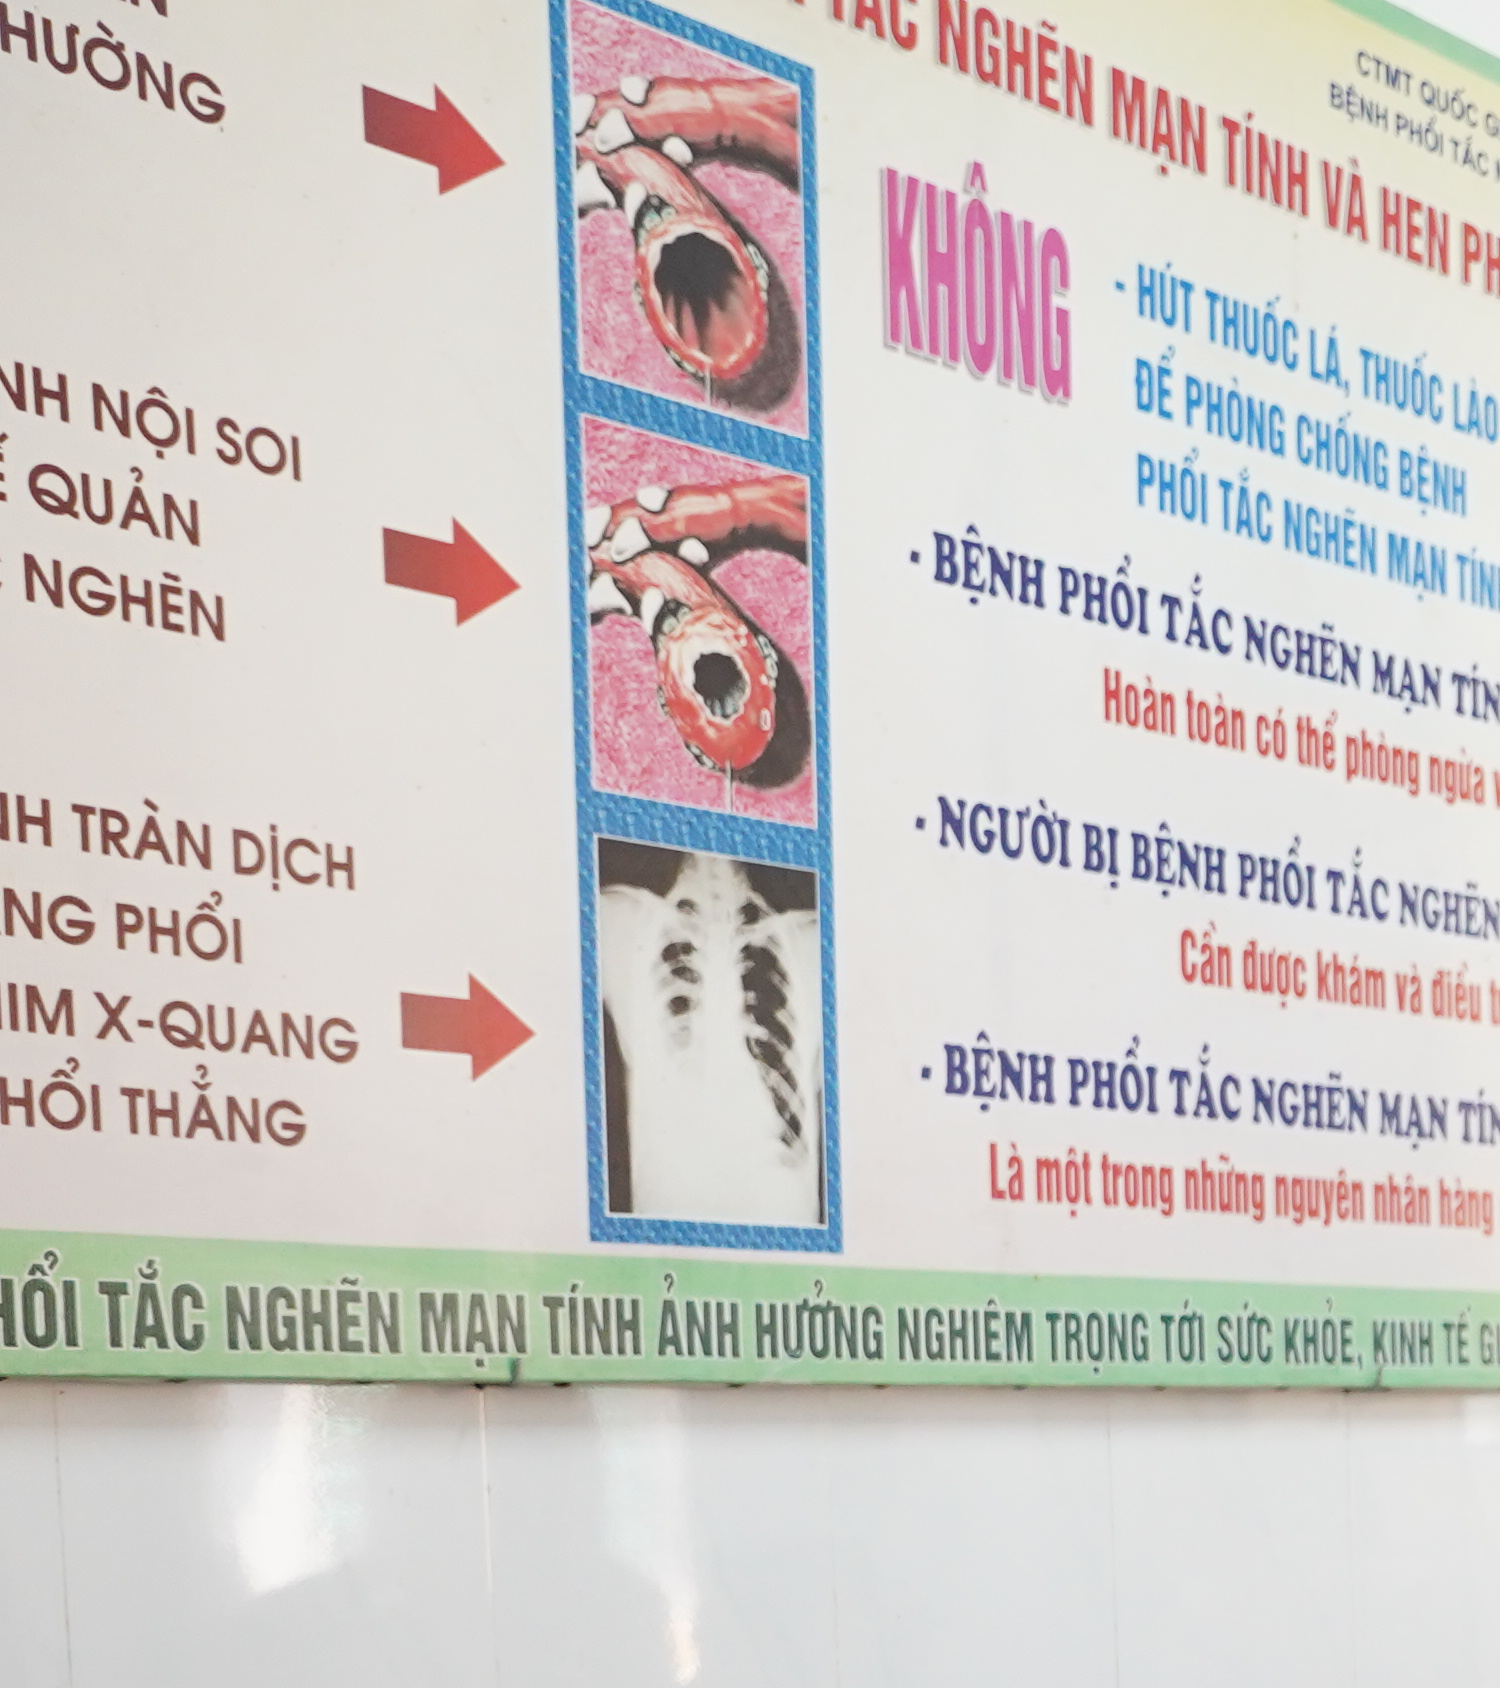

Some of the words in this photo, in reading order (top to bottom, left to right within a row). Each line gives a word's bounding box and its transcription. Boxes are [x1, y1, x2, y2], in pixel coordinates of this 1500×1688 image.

[937, 0, 1094, 127] NGHẼN
[1111, 66, 1207, 176] MẠN
[1222, 112, 1309, 217] TÍNH
[1322, 156, 1368, 243] VÀ
[1380, 186, 1450, 276] HEN
[1328, 81, 1389, 133] BỆNH
[1395, 112, 1445, 157] PHỔI
[1449, 134, 1490, 178] TẮC
[1355, 50, 1413, 96] CTMT
[1420, 80, 1480, 128] QUỐC
[884, 161, 1072, 402] KHÔNG
[1137, 261, 1194, 333] HÚT
[1205, 289, 1299, 371] THUỐC
[1310, 324, 1351, 398] LÁ,
[1359, 347, 1444, 425] THUỐC
[1453, 376, 1500, 445] LÀO
[92, 382, 196, 460] NỘI
[216, 417, 302, 482] SOI
[1134, 344, 1175, 422] ĐỂ
[1184, 375, 1286, 459] PHÒNG
[1296, 410, 1390, 492] CHỐNG
[1399, 444, 1468, 518] BỆNH
[28, 463, 201, 547] QUẢN
[1136, 446, 1208, 527] PHỔI
[1218, 466, 1273, 545] TẮC
[1282, 498, 1378, 577] NGHẼN
[1387, 532, 1448, 602] MẠN
[933, 524, 1045, 609] BỆNH
[1057, 554, 1150, 636] PHỔI
[1160, 572, 1233, 656] TẮC
[1244, 615, 1363, 688] NGHẼN
[1371, 649, 1442, 714] MẠN
[1103, 667, 1177, 736] Hoàn
[1186, 689, 1246, 752] toàn
[1255, 706, 1287, 761] có
[1296, 710, 1338, 772] thể
[1345, 727, 1421, 797] phòng
[1429, 747, 1486, 806] ngừa
[71, 798, 213, 871] TRÀN
[231, 824, 356, 892] DỊCH
[937, 795, 1072, 869] NGƯỜI
[1081, 823, 1121, 890] BỊ
[1130, 821, 1227, 898] BỆNH
[1237, 833, 1317, 910] PHỔI
[1326, 846, 1391, 922] TẮC
[1398, 880, 1500, 942] NGHẼN
[0, 887, 96, 946] NG
[115, 890, 243, 964] PHỔI
[1180, 919, 1233, 988] Cần
[1243, 938, 1307, 1010] được
[1316, 949, 1387, 1010] khám
[1395, 962, 1424, 1016] và
[1431, 961, 1482, 1024] điều
[0, 982, 76, 1038] IM
[93, 991, 360, 1064] X-QUANG
[119, 1063, 307, 1148] THẲNG
[944, 1029, 1056, 1113] BỆNH
[1067, 1033, 1160, 1115] PHỔI
[1169, 1041, 1242, 1121] TẮC
[1251, 1070, 1369, 1134] NGHẼN
[1379, 1090, 1449, 1151] MẠN
[989, 1140, 1025, 1202] Là
[1035, 1145, 1092, 1218] một
[1100, 1151, 1175, 1217] trong
[1184, 1152, 1266, 1222] những
[1275, 1168, 1365, 1226] nguyên
[1373, 1171, 1431, 1226] nhân
[1439, 1176, 1494, 1237] hàng
[98, 1258, 205, 1351] TẮC
[225, 1275, 401, 1354] NGHẼN
[418, 1291, 528, 1368] MẠN
[542, 1281, 642, 1356] TÍNH
[658, 1272, 741, 1358] ẢNH
[755, 1278, 885, 1361] HƯỞNG
[897, 1299, 1034, 1363] NGHIÊM
[1045, 1310, 1150, 1374] TRỌNG
[1160, 1298, 1206, 1363] TỚI
[1217, 1301, 1273, 1364] SỨC
[1284, 1296, 1364, 1369] KHỎE,
[1372, 1319, 1434, 1367] KINH
[1443, 1305, 1471, 1367] TẾ
